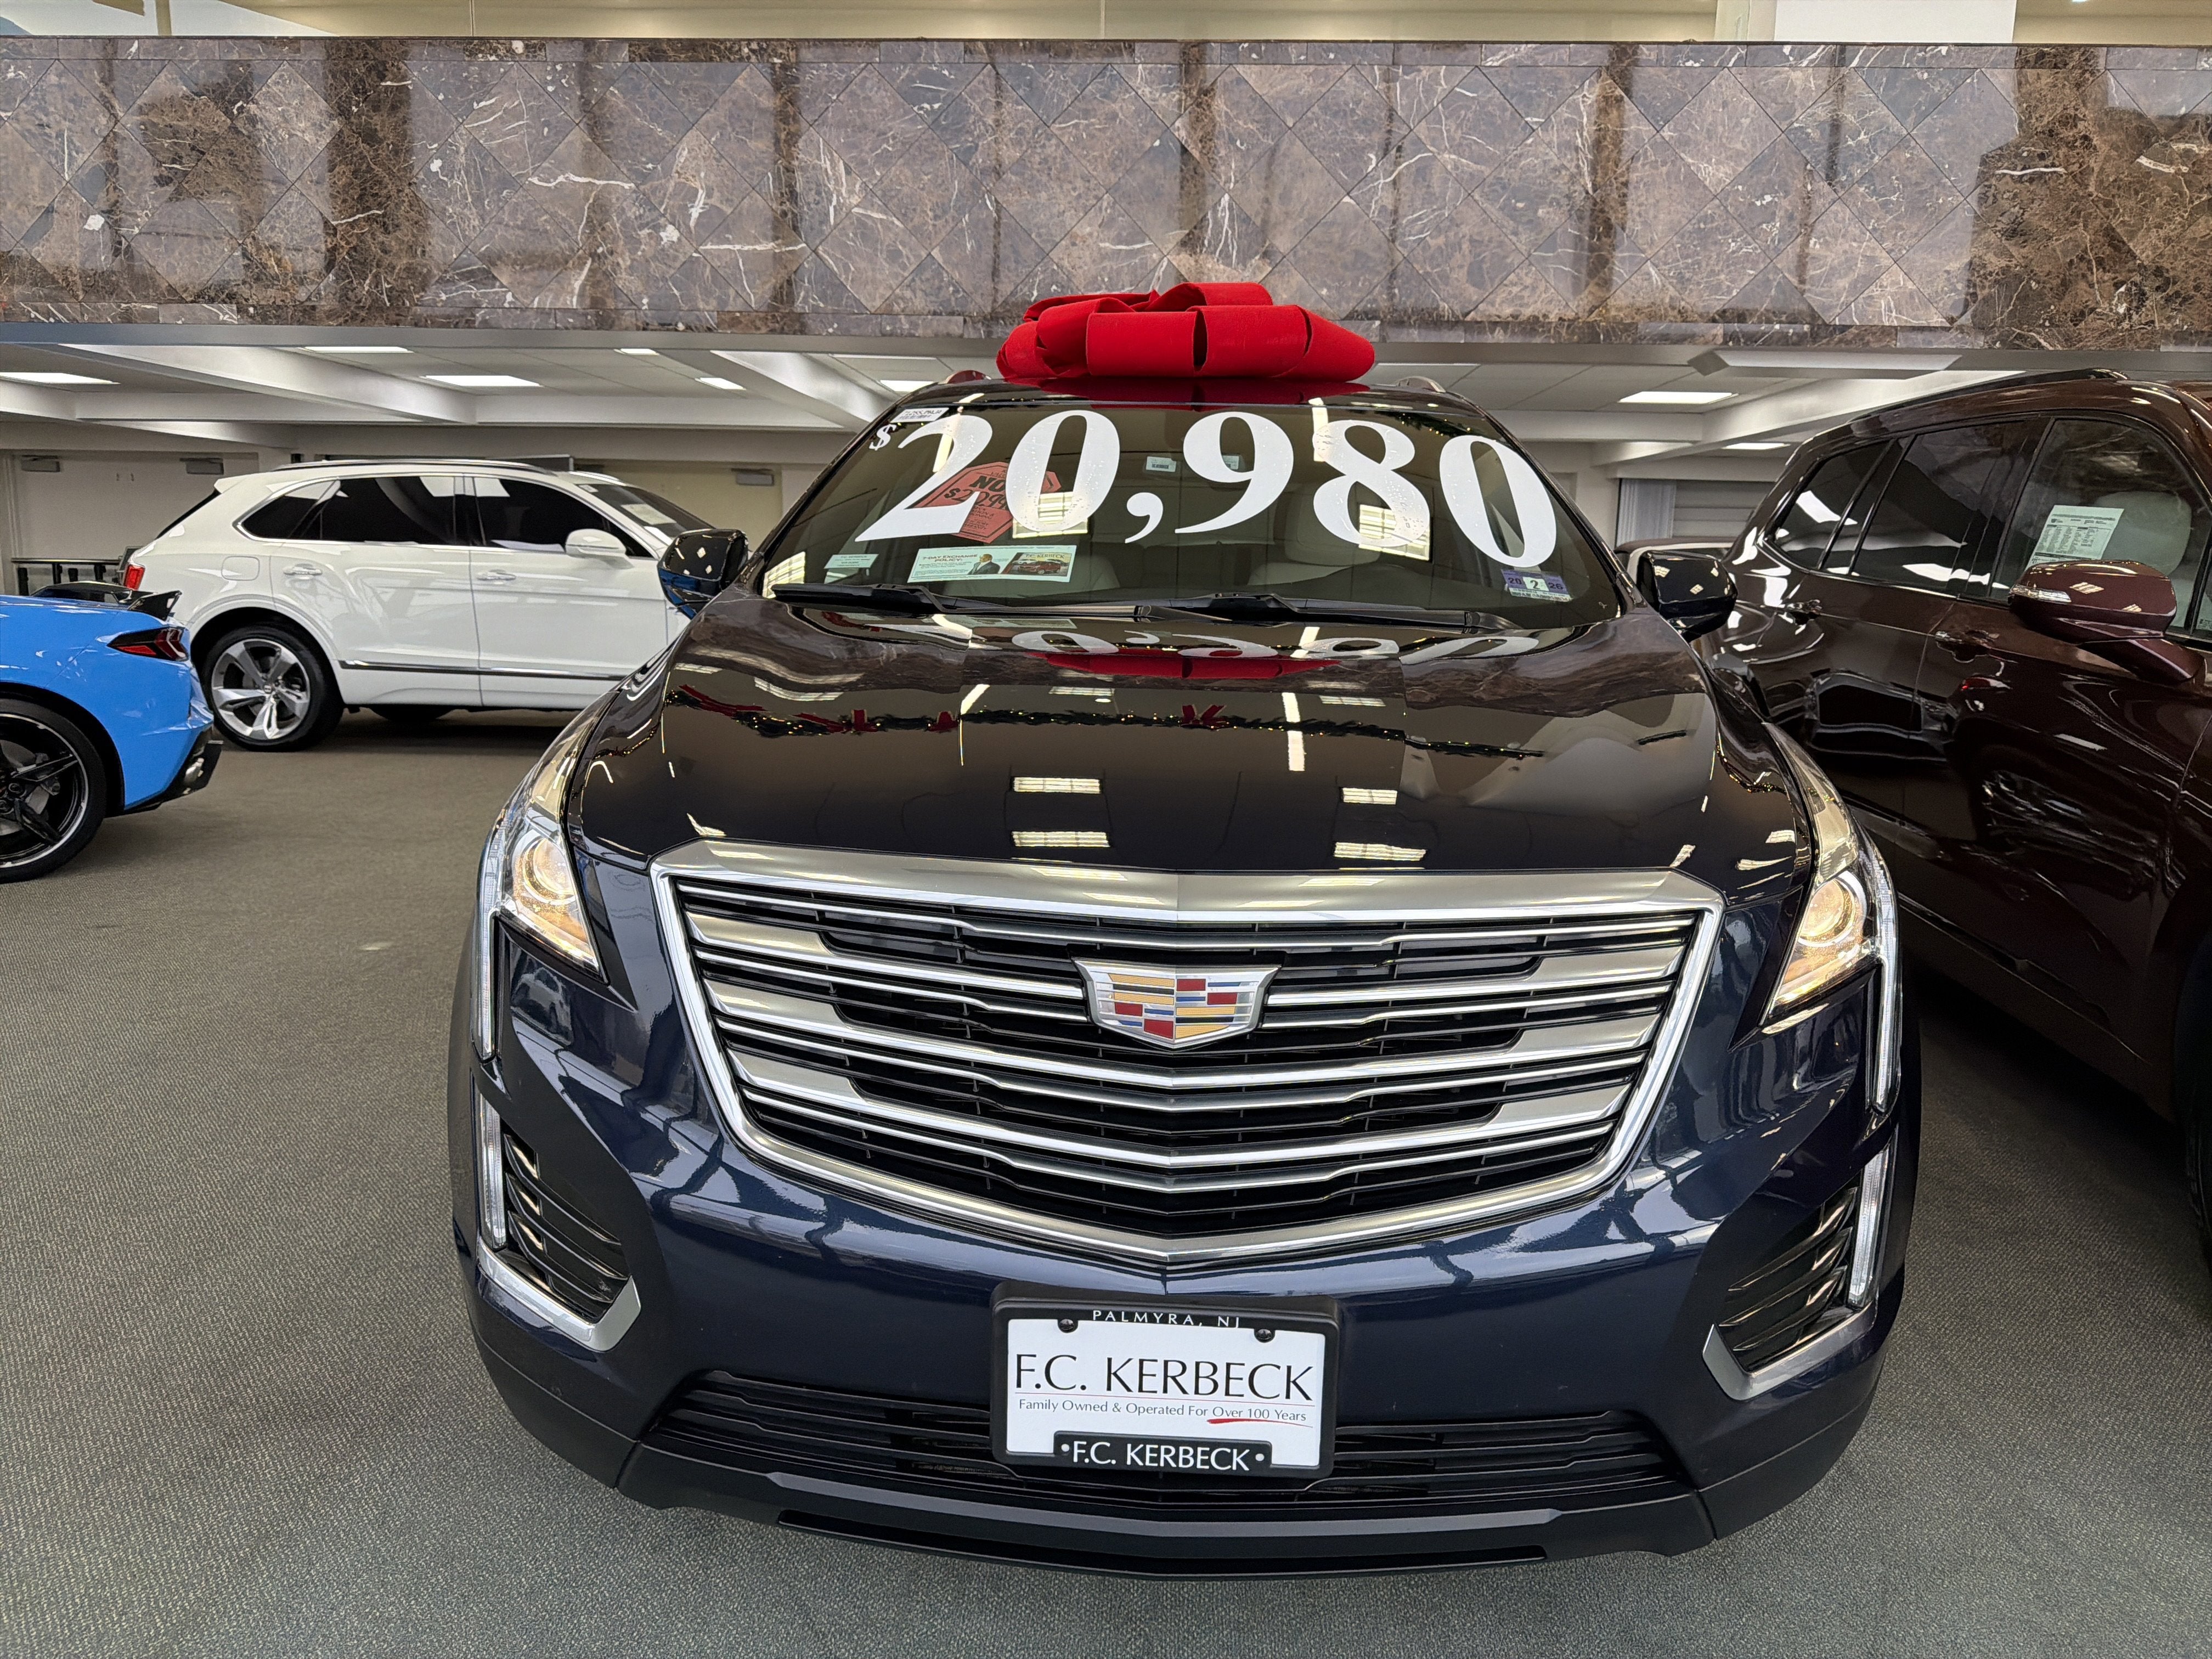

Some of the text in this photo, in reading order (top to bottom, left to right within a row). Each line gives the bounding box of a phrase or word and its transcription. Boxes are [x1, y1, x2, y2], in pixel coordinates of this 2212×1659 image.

[969, 475, 1006, 492] NO
[1530, 580, 1541, 590] 2
[1093, 1310, 1239, 1328] PALMYRA, NJ
[1015, 1353, 1313, 1401] F.C. KERBECK
[1019, 1398, 1307, 1421] Family Owned & Operated For Over 100 Years
[1073, 1441, 1250, 1471] F.C. KERBECK
